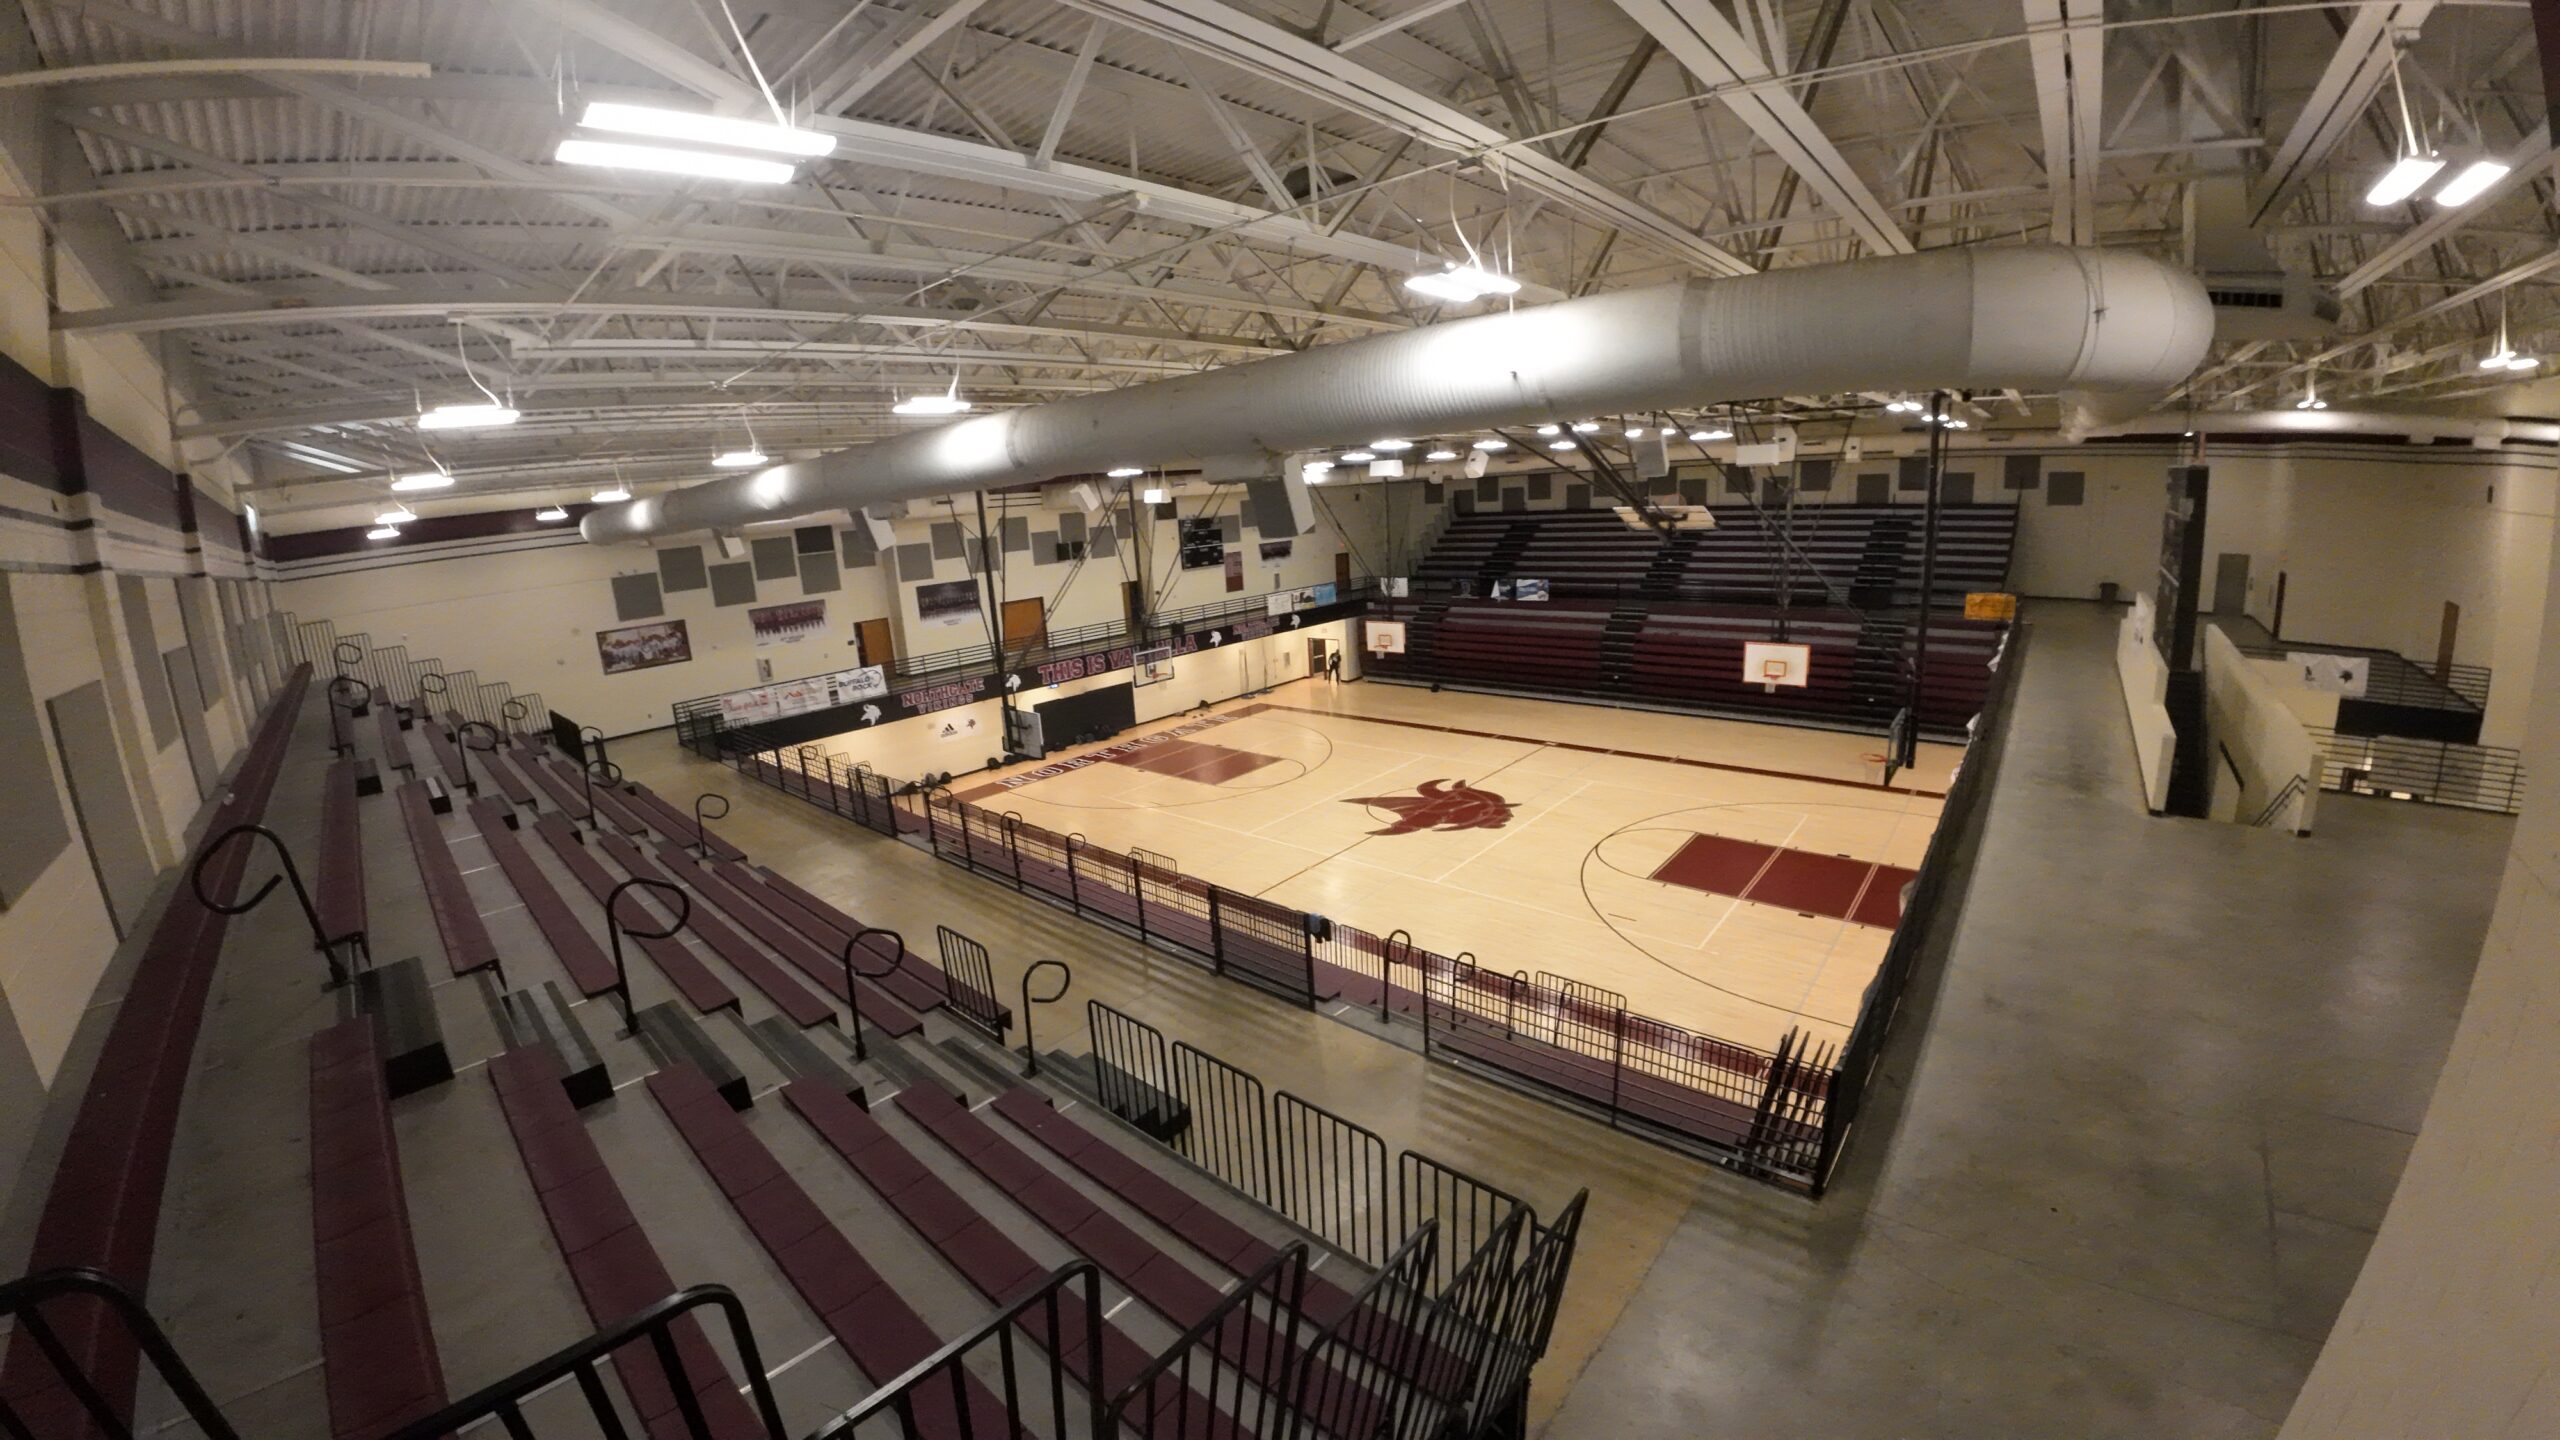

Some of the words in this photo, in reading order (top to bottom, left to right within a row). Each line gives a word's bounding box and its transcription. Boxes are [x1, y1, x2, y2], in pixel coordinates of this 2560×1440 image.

[1038, 658, 1085, 685] THIS
[1086, 653, 1106, 675] IS
[901, 678, 985, 708] NORTHGATE
